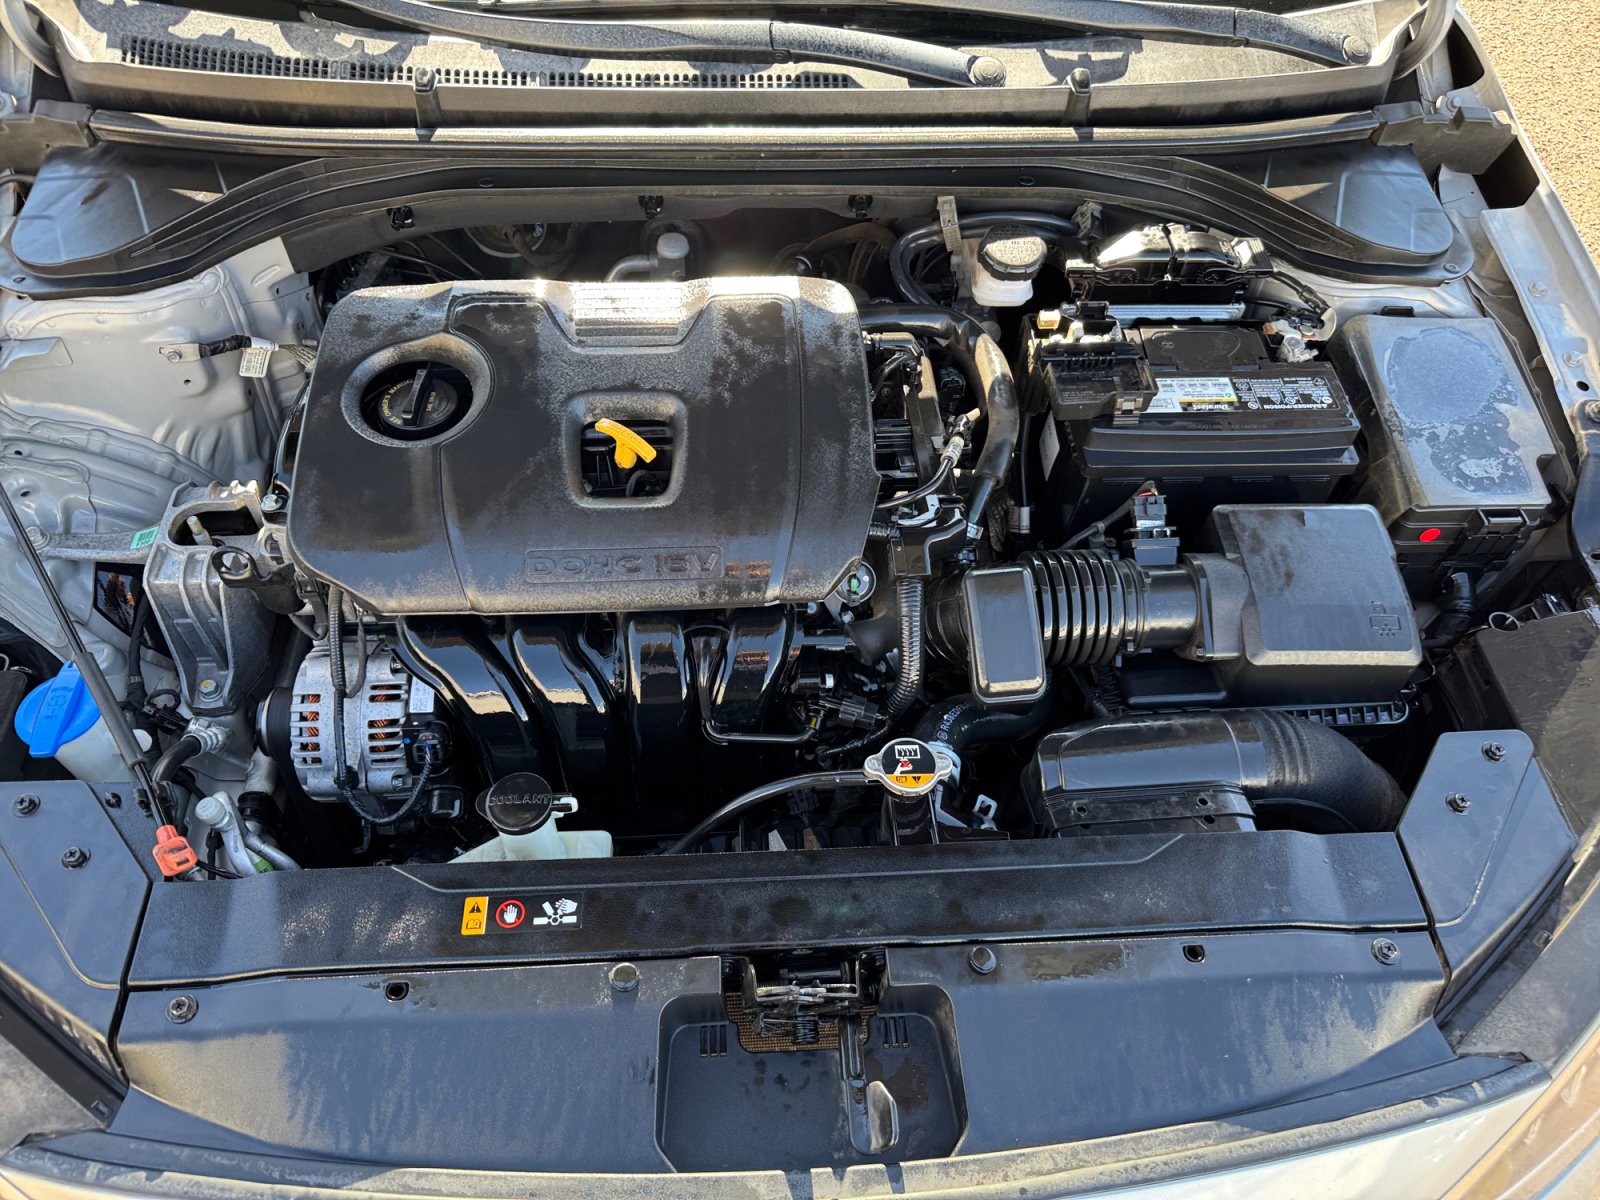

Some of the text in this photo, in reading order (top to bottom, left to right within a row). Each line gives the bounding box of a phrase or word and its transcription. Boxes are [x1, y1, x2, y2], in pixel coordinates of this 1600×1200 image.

[1191, 402, 1230, 411] Duralast
[528, 553, 719, 576] DOHC 16V
[488, 793, 551, 806] COOLANT
